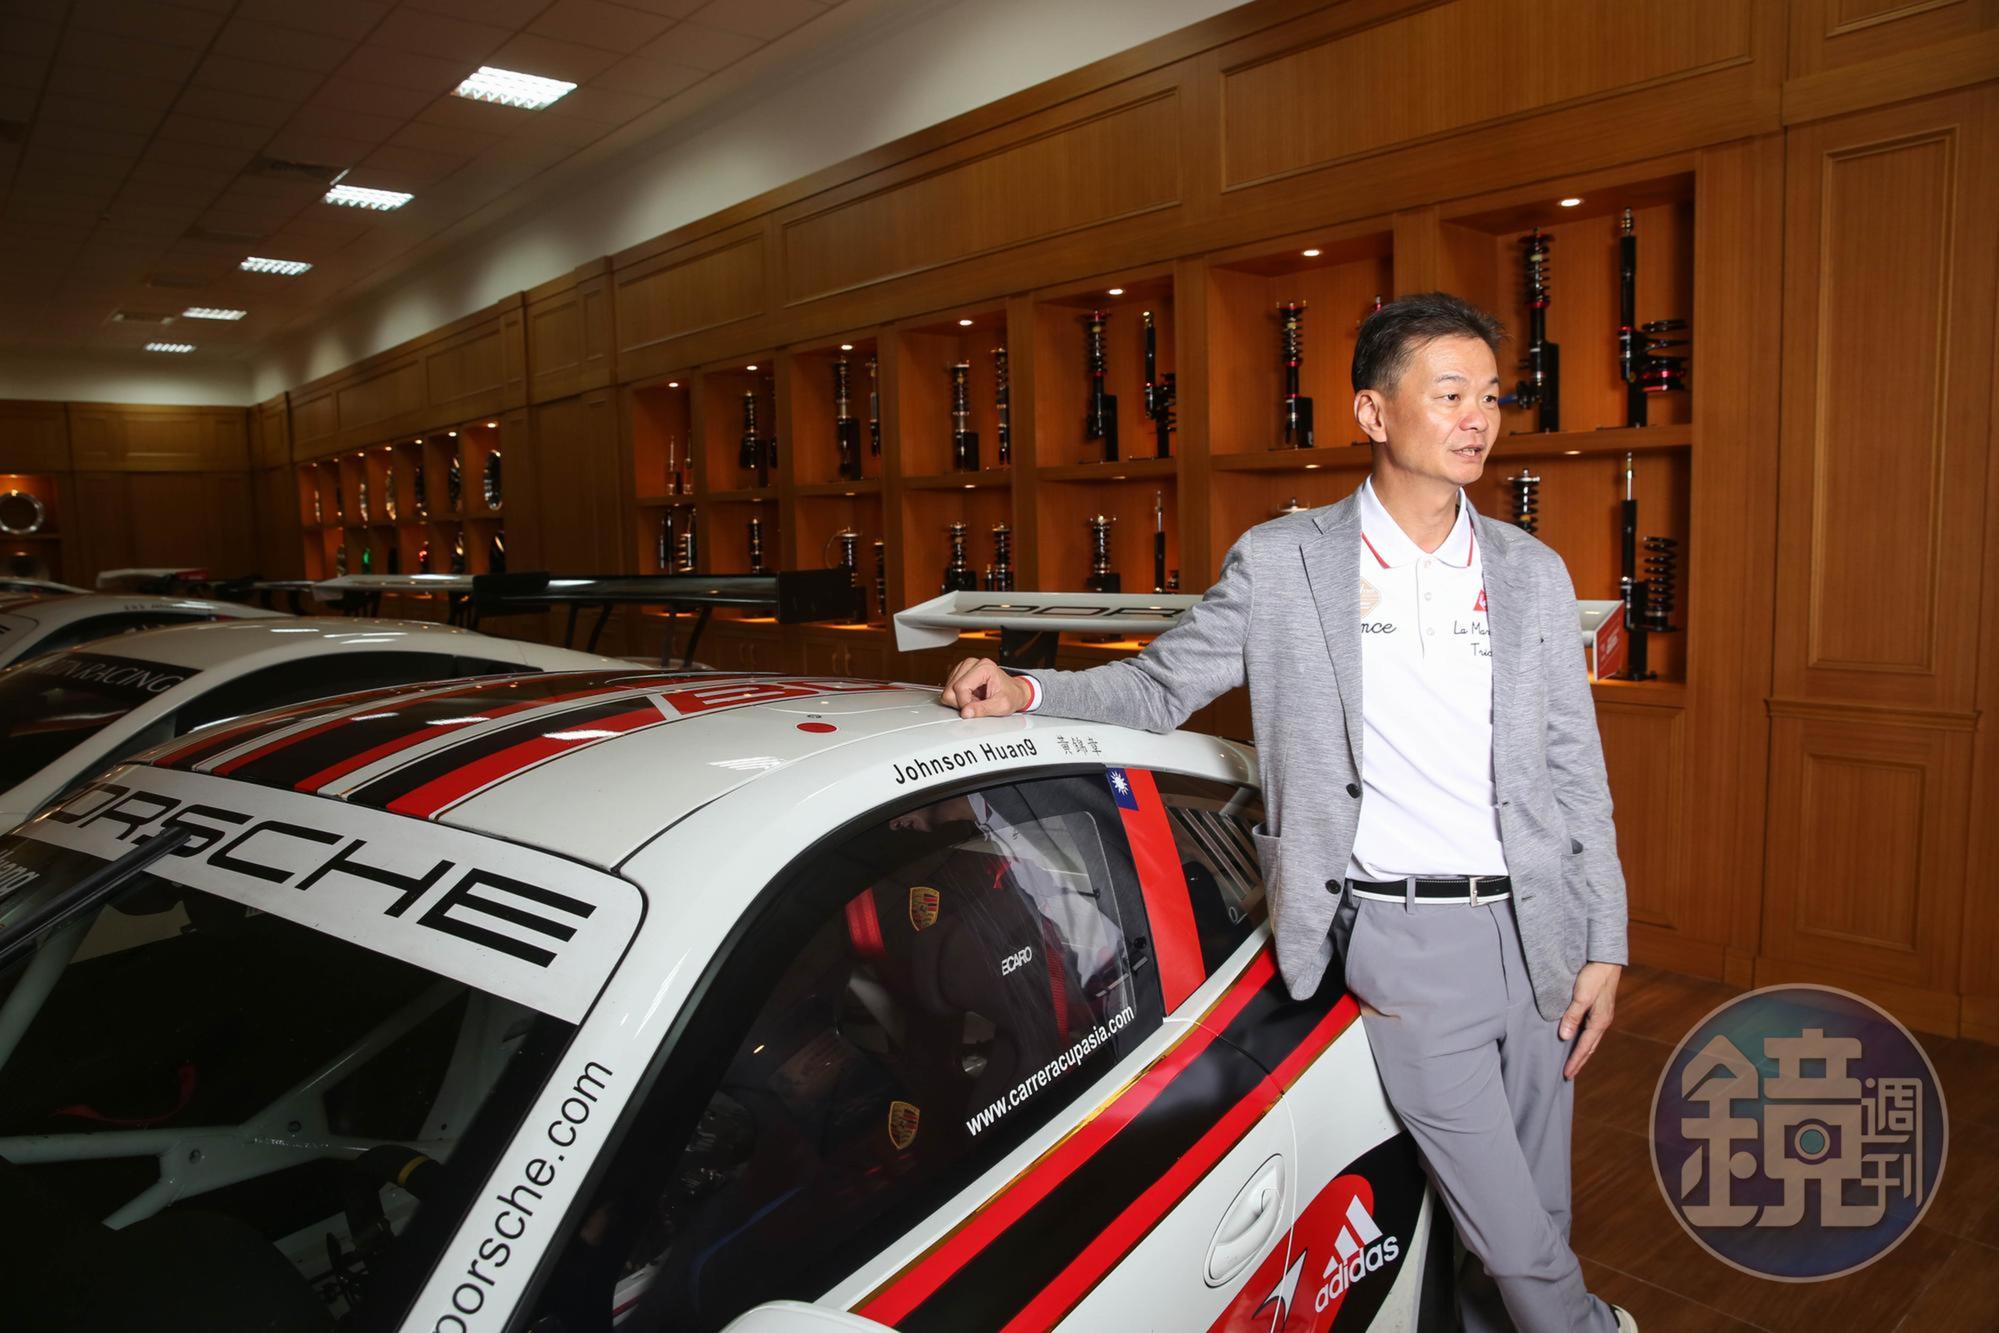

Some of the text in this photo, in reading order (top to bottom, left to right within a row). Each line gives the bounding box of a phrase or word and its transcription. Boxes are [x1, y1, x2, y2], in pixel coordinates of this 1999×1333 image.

[966, 604, 1185, 618] POR
[1361, 622, 1397, 634] nce
[893, 736, 1038, 785] Johnson Huang
[46, 781, 597, 968] ORSCHE
[966, 1004, 1135, 1137] www.carreracupasia.com
[1314, 1235, 1400, 1313] adidas
